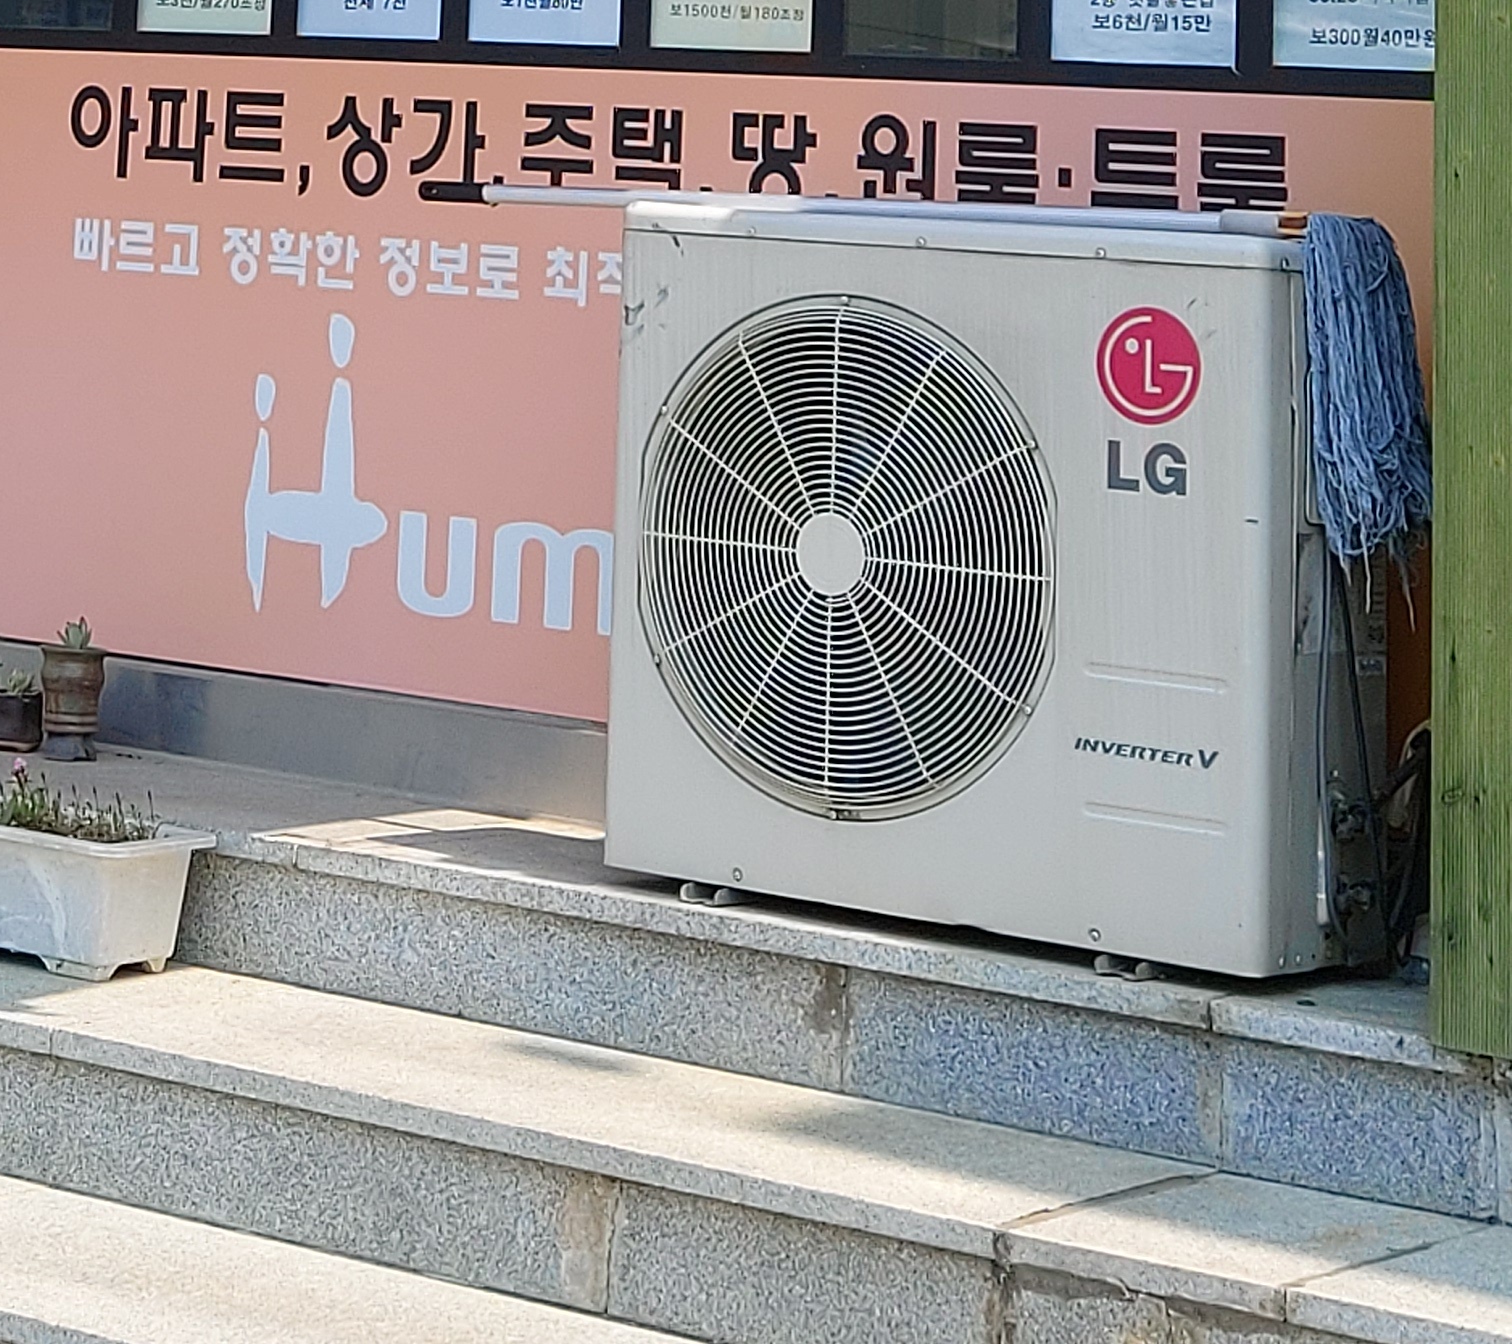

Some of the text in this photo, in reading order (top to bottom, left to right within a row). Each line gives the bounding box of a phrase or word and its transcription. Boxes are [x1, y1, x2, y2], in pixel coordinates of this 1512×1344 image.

[73, 217, 200, 276] 빠르고
[222, 226, 360, 290] 정확한
[379, 236, 520, 300] 정보로
[1106, 438, 1188, 497] LG
[1074, 736, 1195, 767] INVERTER
